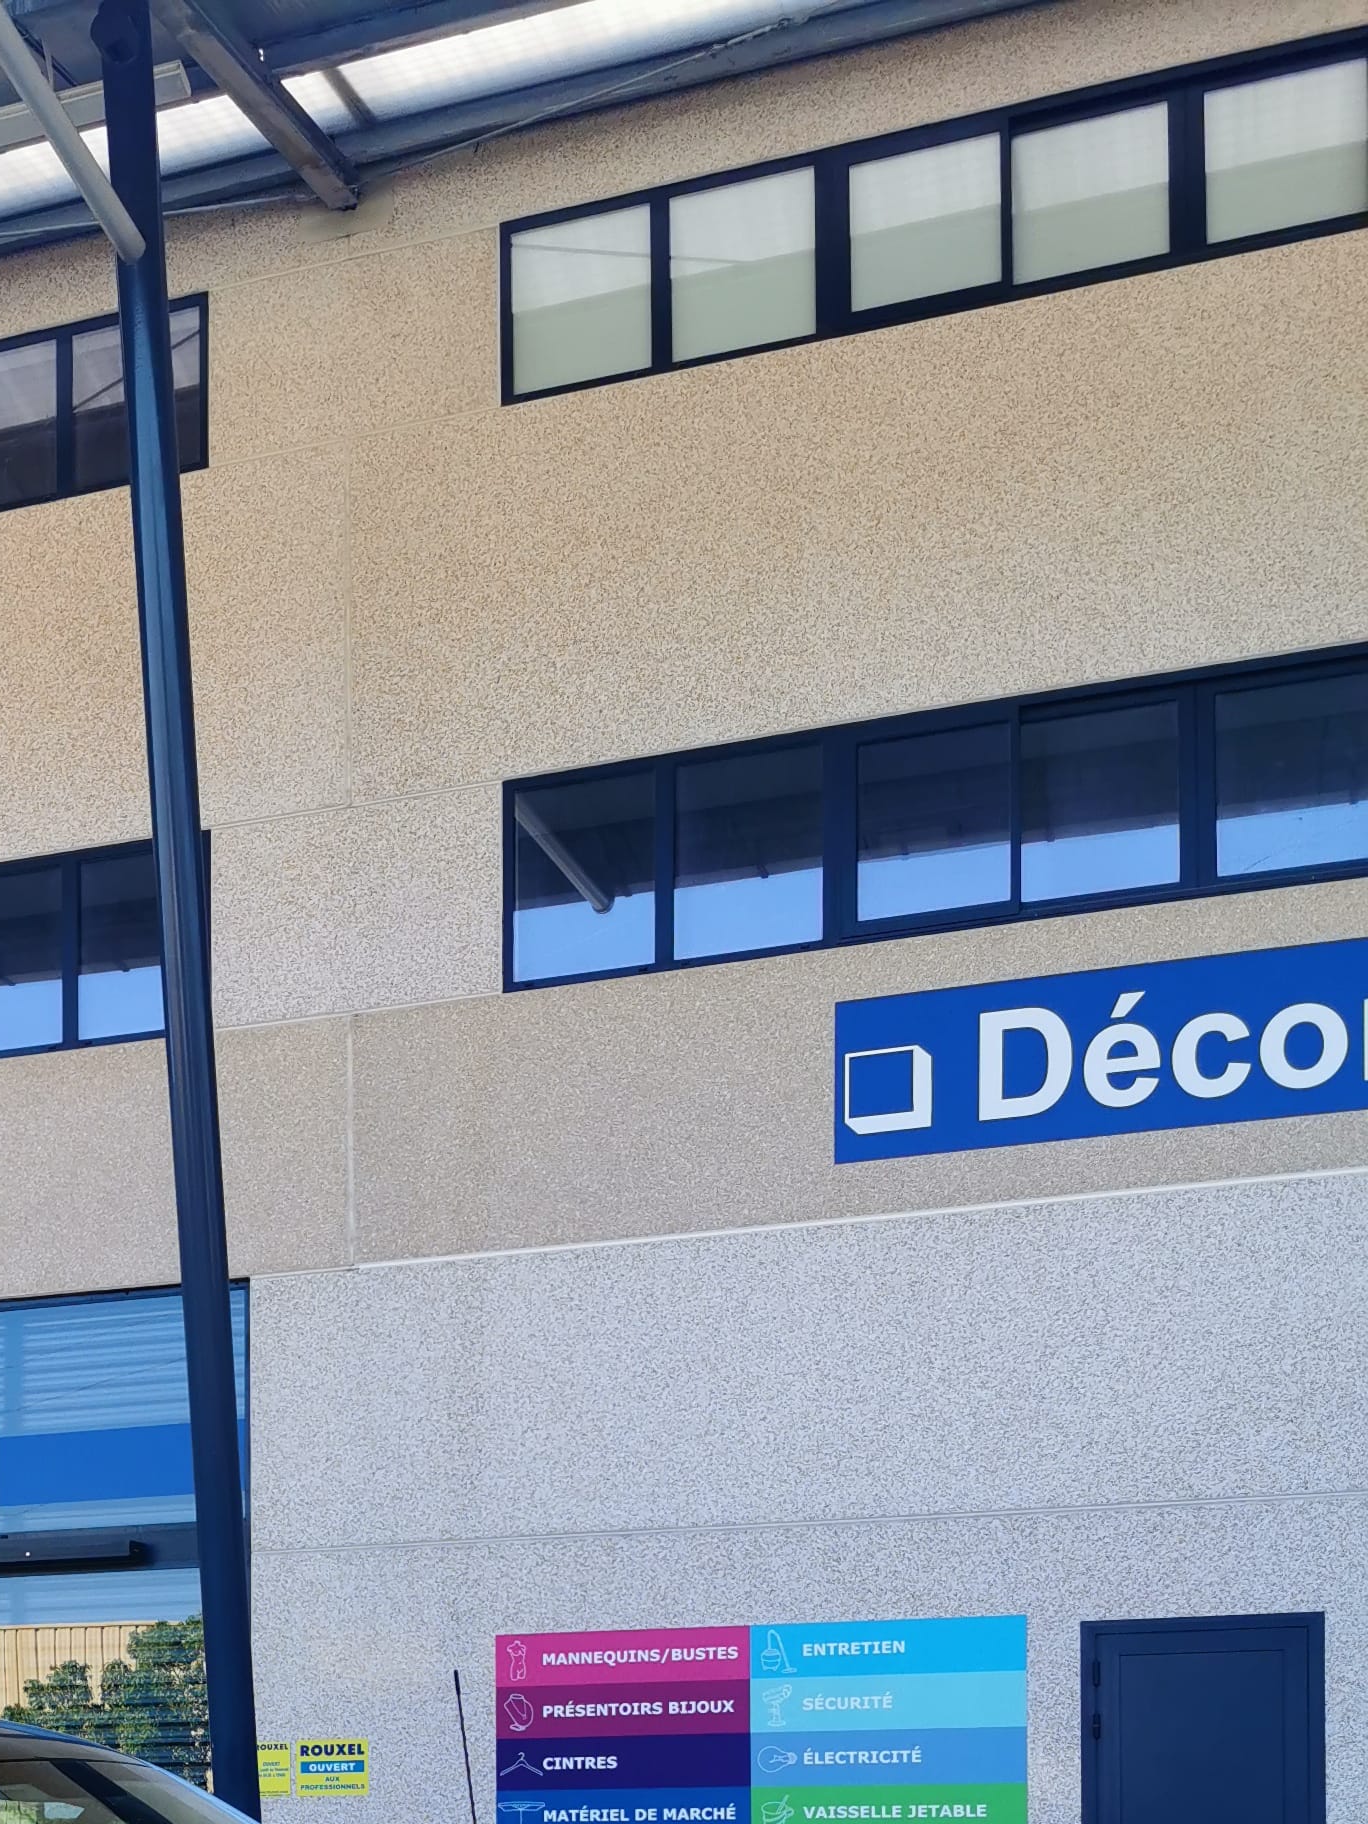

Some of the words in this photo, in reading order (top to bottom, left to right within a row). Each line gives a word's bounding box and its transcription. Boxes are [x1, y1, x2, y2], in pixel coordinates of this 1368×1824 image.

[979, 991, 1368, 1121] Déco
[542, 1647, 739, 1666] MANNEQUINS/BUSTES
[802, 1640, 906, 1657] ENTRETIEN
[542, 1701, 664, 1719] PRÉSENTOIRS
[668, 1700, 735, 1715] BIJOUX
[802, 1691, 893, 1711] SÉCURITÉ
[300, 1744, 365, 1757] ROUXEL
[803, 1746, 922, 1765] ÉLECTRICITÉ
[308, 1763, 356, 1772] OUVERT
[542, 1756, 618, 1770] CINTRES
[543, 1806, 629, 1822] MATÉRIEL
[635, 1808, 657, 1821] DE
[663, 1803, 736, 1821] MARCHÉ
[803, 1806, 901, 1819] VAISSELLE
[907, 1804, 987, 1818] JETABLE
